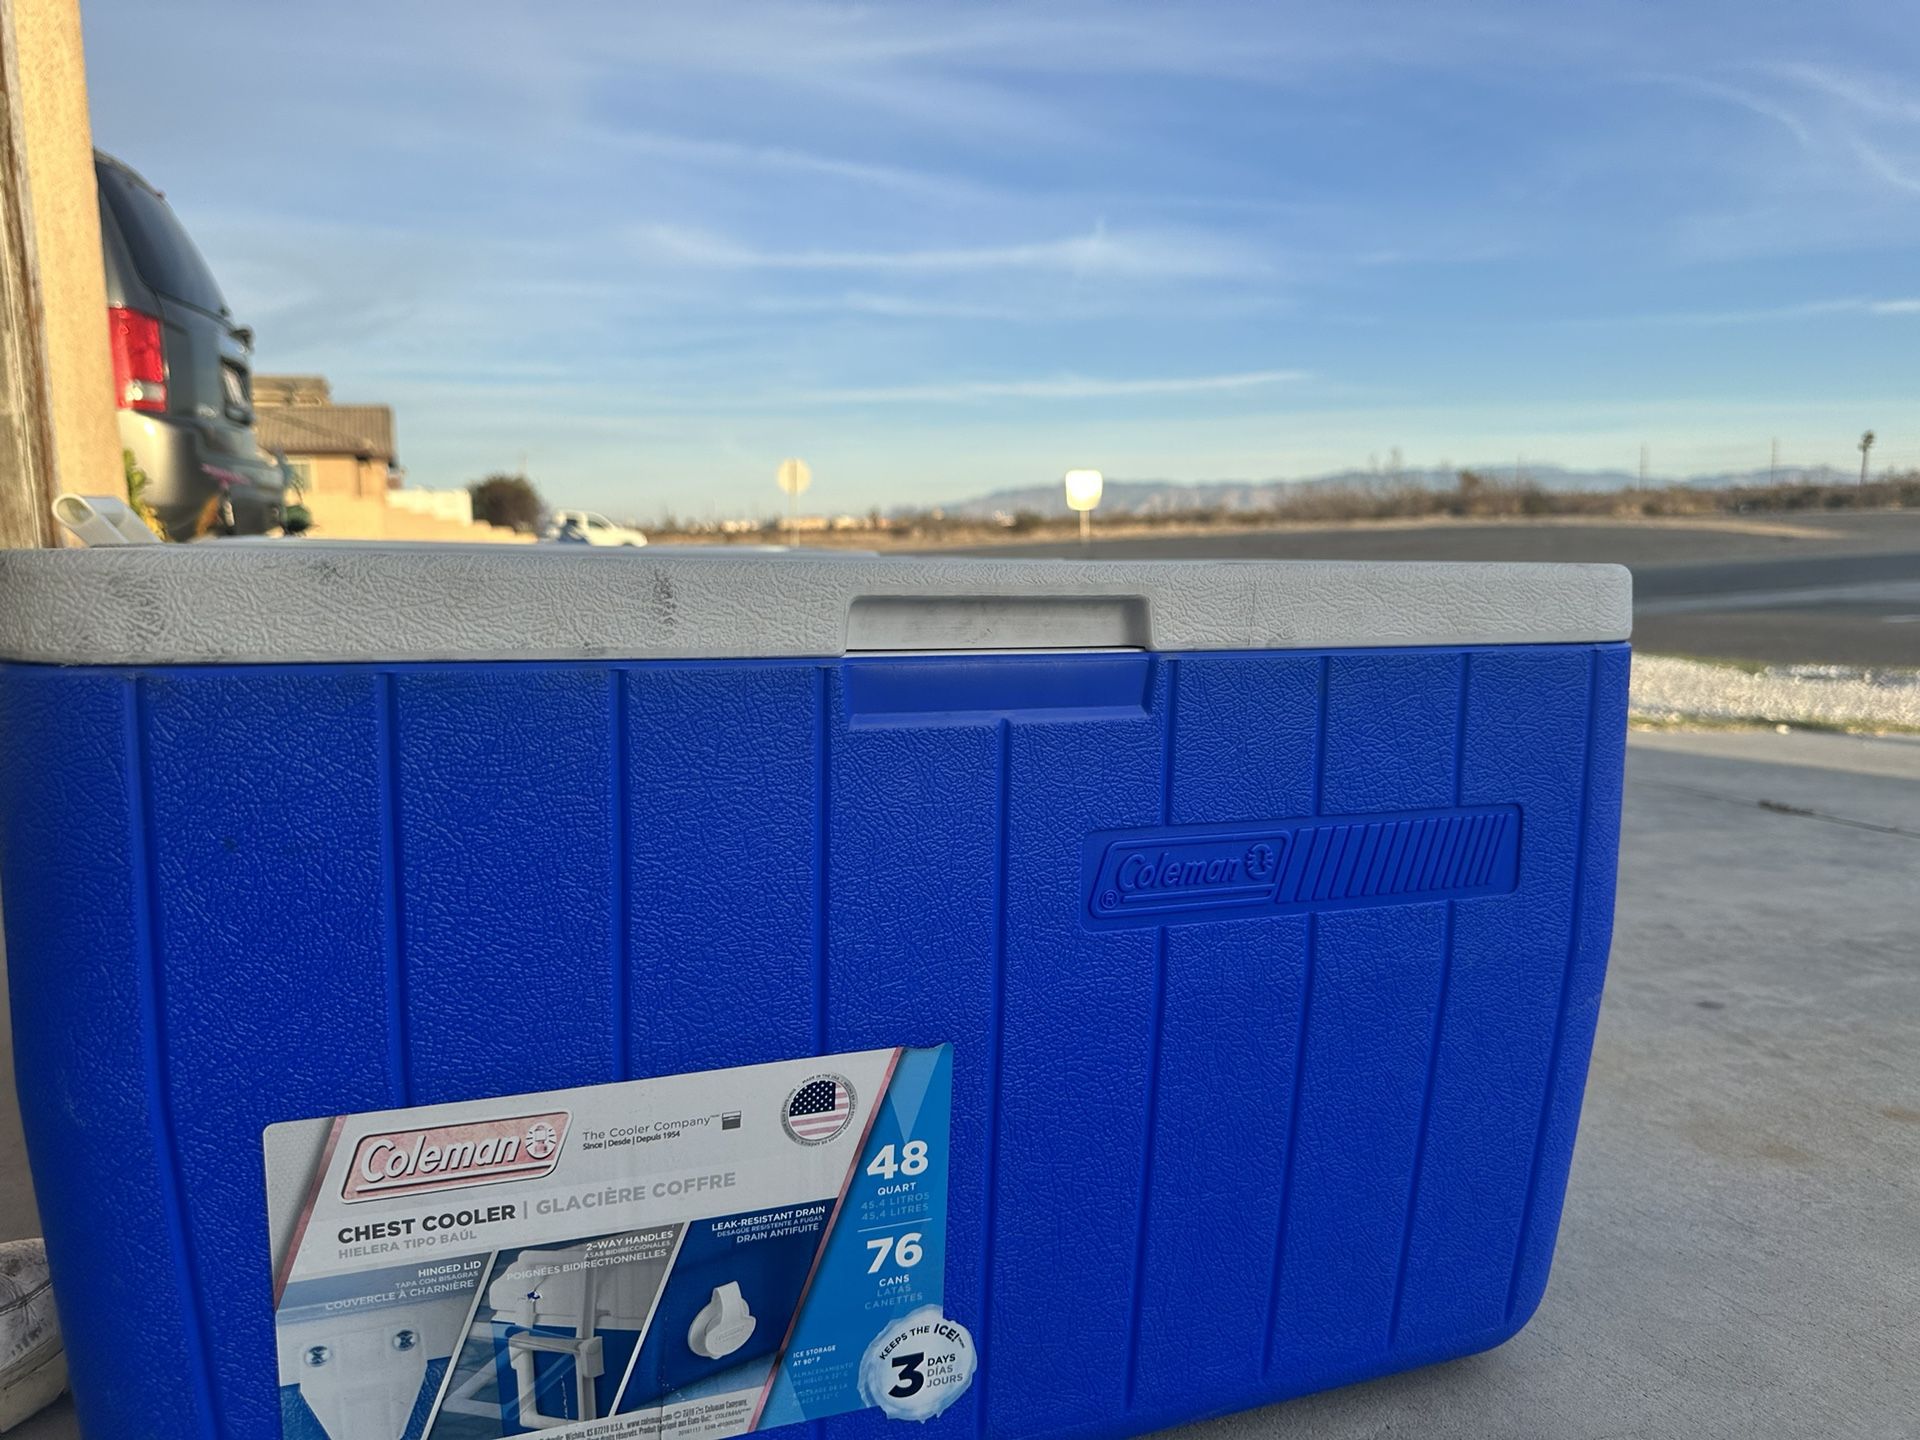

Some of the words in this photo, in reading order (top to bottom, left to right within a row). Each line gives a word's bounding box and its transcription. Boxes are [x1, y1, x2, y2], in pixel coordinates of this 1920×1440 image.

[1116, 852, 1242, 893] Coleman
[583, 1131, 605, 1141] The
[609, 1125, 650, 1138] Cooler
[653, 1116, 711, 1132] Company
[582, 1142, 604, 1151] Since
[608, 1138, 632, 1147] Desde
[636, 1133, 662, 1144] Depuis
[663, 1130, 681, 1140] 1954
[360, 1135, 521, 1183] Coleman
[866, 1140, 929, 1180] 48
[877, 1182, 917, 1196] QUART
[890, 1191, 930, 1206] LITROS
[338, 1218, 416, 1244] CHEST
[422, 1204, 517, 1232] COOLER
[536, 1186, 646, 1216] GLACIÈRE
[652, 1172, 737, 1198] COFFRE
[711, 1210, 794, 1232] LEAK-RESISTANT
[795, 1205, 826, 1218] DRAIN
[890, 1202, 929, 1217] LITRES
[736, 1231, 768, 1244] DRAIN
[769, 1222, 820, 1239] ANTIFUITE
[751, 1219, 793, 1232] RESISTENTE
[800, 1215, 823, 1225] FUGAS
[338, 1241, 401, 1260] HIELERA
[404, 1236, 436, 1250] TIPO
[440, 1229, 478, 1245] BAÚL
[586, 1238, 624, 1251] 2-WAY
[625, 1230, 674, 1245] HANDLES
[583, 1250, 604, 1260] ASAS
[866, 1232, 923, 1275] 76
[418, 1263, 461, 1278] HINGED
[464, 1261, 482, 1271] LID
[506, 1265, 561, 1281] POIGNÉES
[562, 1248, 668, 1272] BIDIRECTIONNELLES
[395, 1280, 418, 1290] TAPA
[419, 1277, 437, 1286] CON
[439, 1271, 479, 1283] BISAGRAS
[876, 1283, 912, 1297] LATAS
[879, 1273, 910, 1287] CANS
[325, 1291, 396, 1311] COUVERCLE
[409, 1280, 475, 1298] CHARNIÈRE
[864, 1292, 923, 1310] CANETTES
[792, 1350, 805, 1359] ICE
[805, 1344, 837, 1357] STORAGE
[879, 1332, 908, 1360] KEEPS
[909, 1325, 931, 1337] THE
[927, 1353, 956, 1367] DAYS
[888, 1351, 925, 1398] 3
[926, 1364, 954, 1378] DÍAS
[926, 1373, 964, 1388] JOURS
